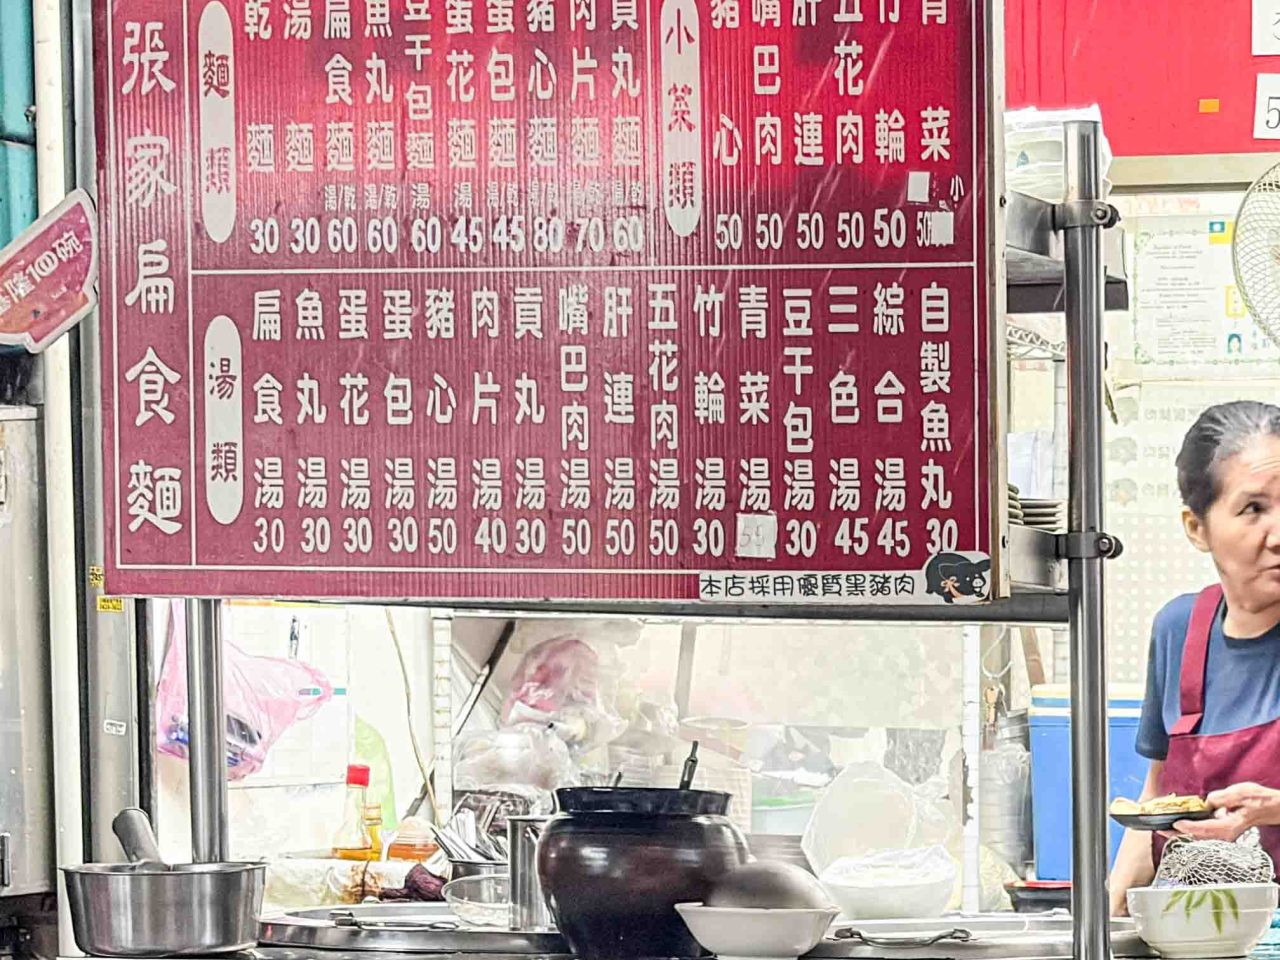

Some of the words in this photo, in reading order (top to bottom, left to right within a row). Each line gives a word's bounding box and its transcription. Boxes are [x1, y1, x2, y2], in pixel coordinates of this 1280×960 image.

[203, 50, 232, 194] 麵類
[665, 9, 695, 209] 小菜類
[950, 174, 964, 202] 小
[249, 218, 278, 254] 30
[290, 218, 320, 254] 30
[327, 217, 357, 254] 60
[367, 217, 397, 253] 60
[412, 217, 441, 253] 60
[452, 216, 483, 252] 45
[493, 215, 525, 252] 45
[533, 215, 563, 252] 80
[576, 214, 604, 252] 70
[613, 214, 643, 252] 60
[715, 211, 743, 250] 50
[756, 211, 783, 250] 50
[796, 211, 824, 250] 50
[837, 210, 864, 249] 50
[873, 209, 906, 249] 50
[122, 22, 182, 535] 張家扁食麵
[252, 289, 285, 510] 扁食湯
[295, 288, 328, 510] 魚丸湯
[338, 289, 372, 510] 蛋花湯
[383, 289, 416, 511] 蛋包湯
[425, 288, 458, 510] 豬心湯
[471, 286, 503, 511] 肉片湯
[514, 287, 546, 511] 貢丸湯
[559, 285, 591, 509] 嘴巴肉湯
[603, 285, 635, 510] 肝連湯
[648, 282, 679, 510] 五花肉湯
[694, 285, 726, 511] 竹輪湯
[739, 285, 770, 511] 青菜湯
[783, 287, 814, 511] 豆干包湯
[828, 285, 861, 511] 三色湯
[873, 282, 906, 511] 綜合湯
[920, 281, 952, 510] 自製魚丸
[209, 358, 238, 483] 湯類
[253, 518, 285, 554] 30
[301, 518, 331, 554] 30
[343, 518, 373, 554] 30
[389, 518, 419, 554] 30
[428, 518, 457, 554] 50
[474, 518, 507, 554] 40
[515, 518, 546, 555] 30
[561, 518, 591, 556] 50
[605, 518, 635, 556] 50
[649, 518, 680, 556] 50
[693, 518, 725, 556] 30
[785, 518, 817, 557] 30
[834, 517, 869, 555] 45
[876, 518, 911, 557] 45
[926, 518, 958, 554] 30
[701, 573, 915, 597] 本店採用優質黑豬肉
